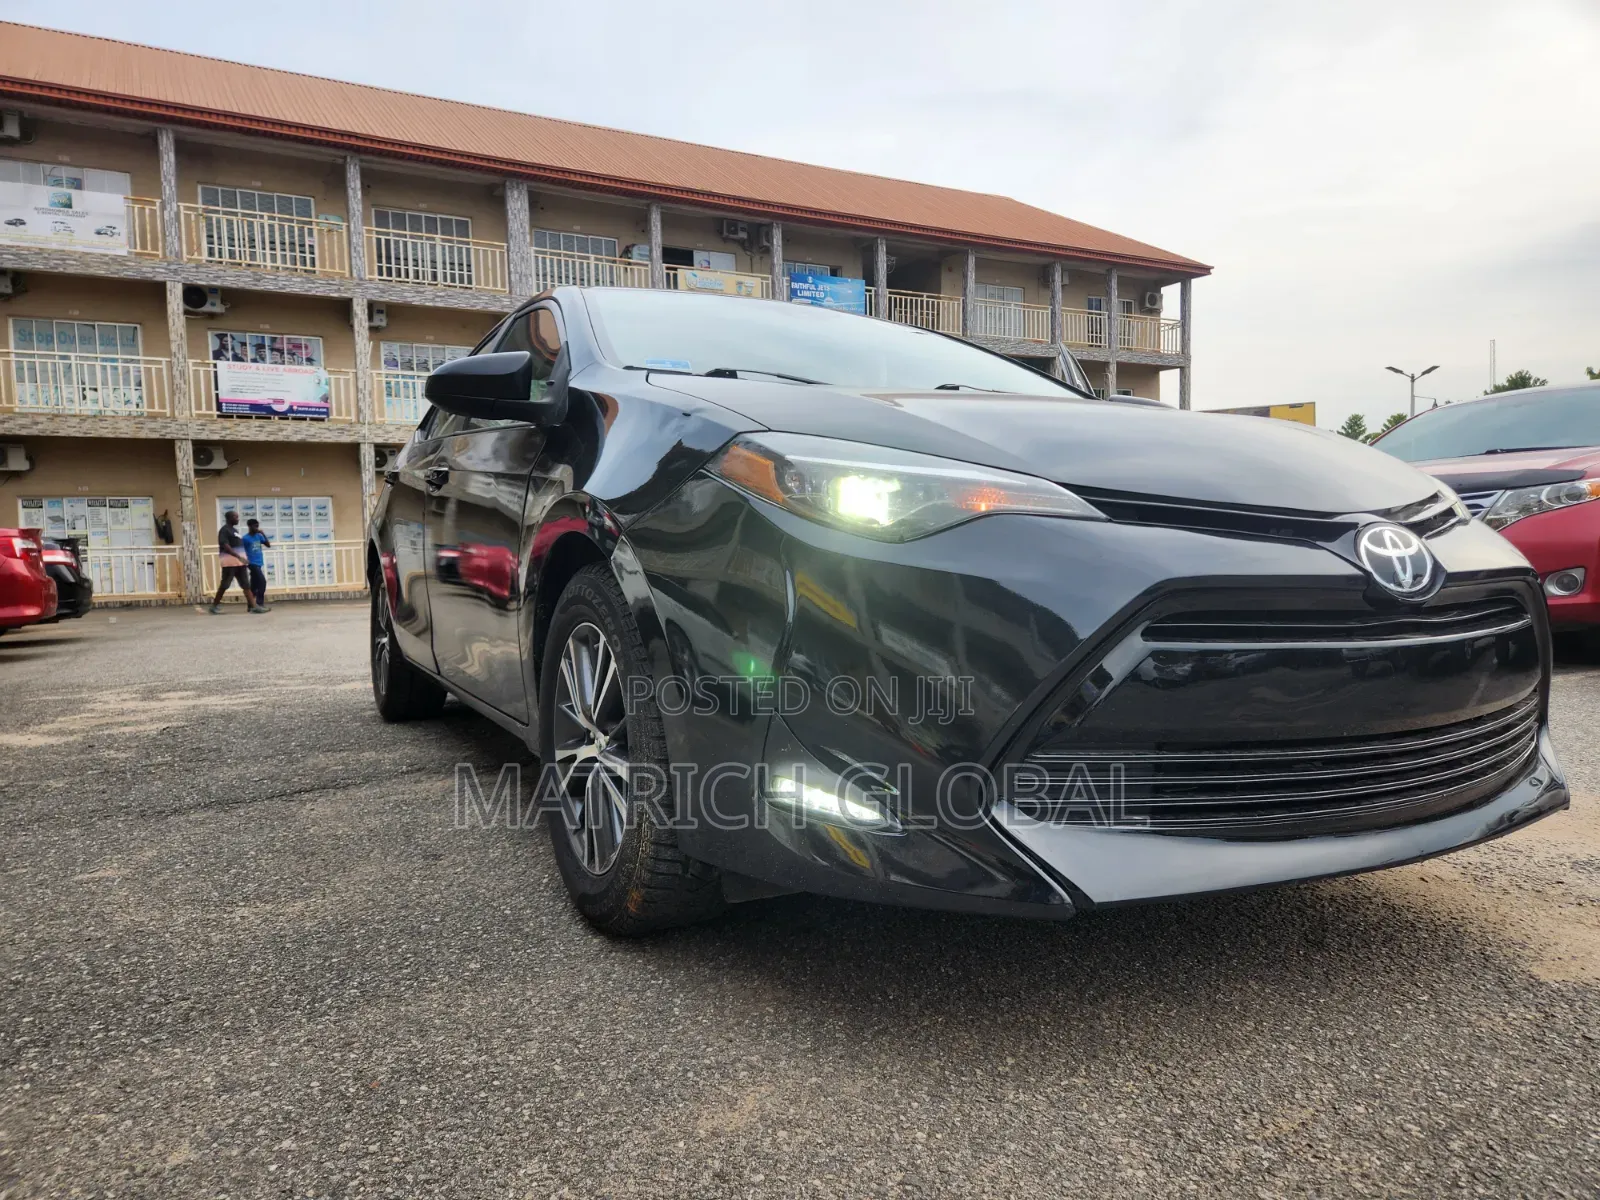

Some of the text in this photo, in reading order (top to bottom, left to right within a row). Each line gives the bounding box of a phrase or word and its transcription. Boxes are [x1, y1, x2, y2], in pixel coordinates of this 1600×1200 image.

[791, 281, 817, 291] FAITHFUL
[797, 290, 825, 298] LIMITED
[17, 328, 53, 346] Stop
[57, 330, 92, 346] Over
[226, 363, 252, 371] STUDY
[282, 367, 315, 375] ABROAD
